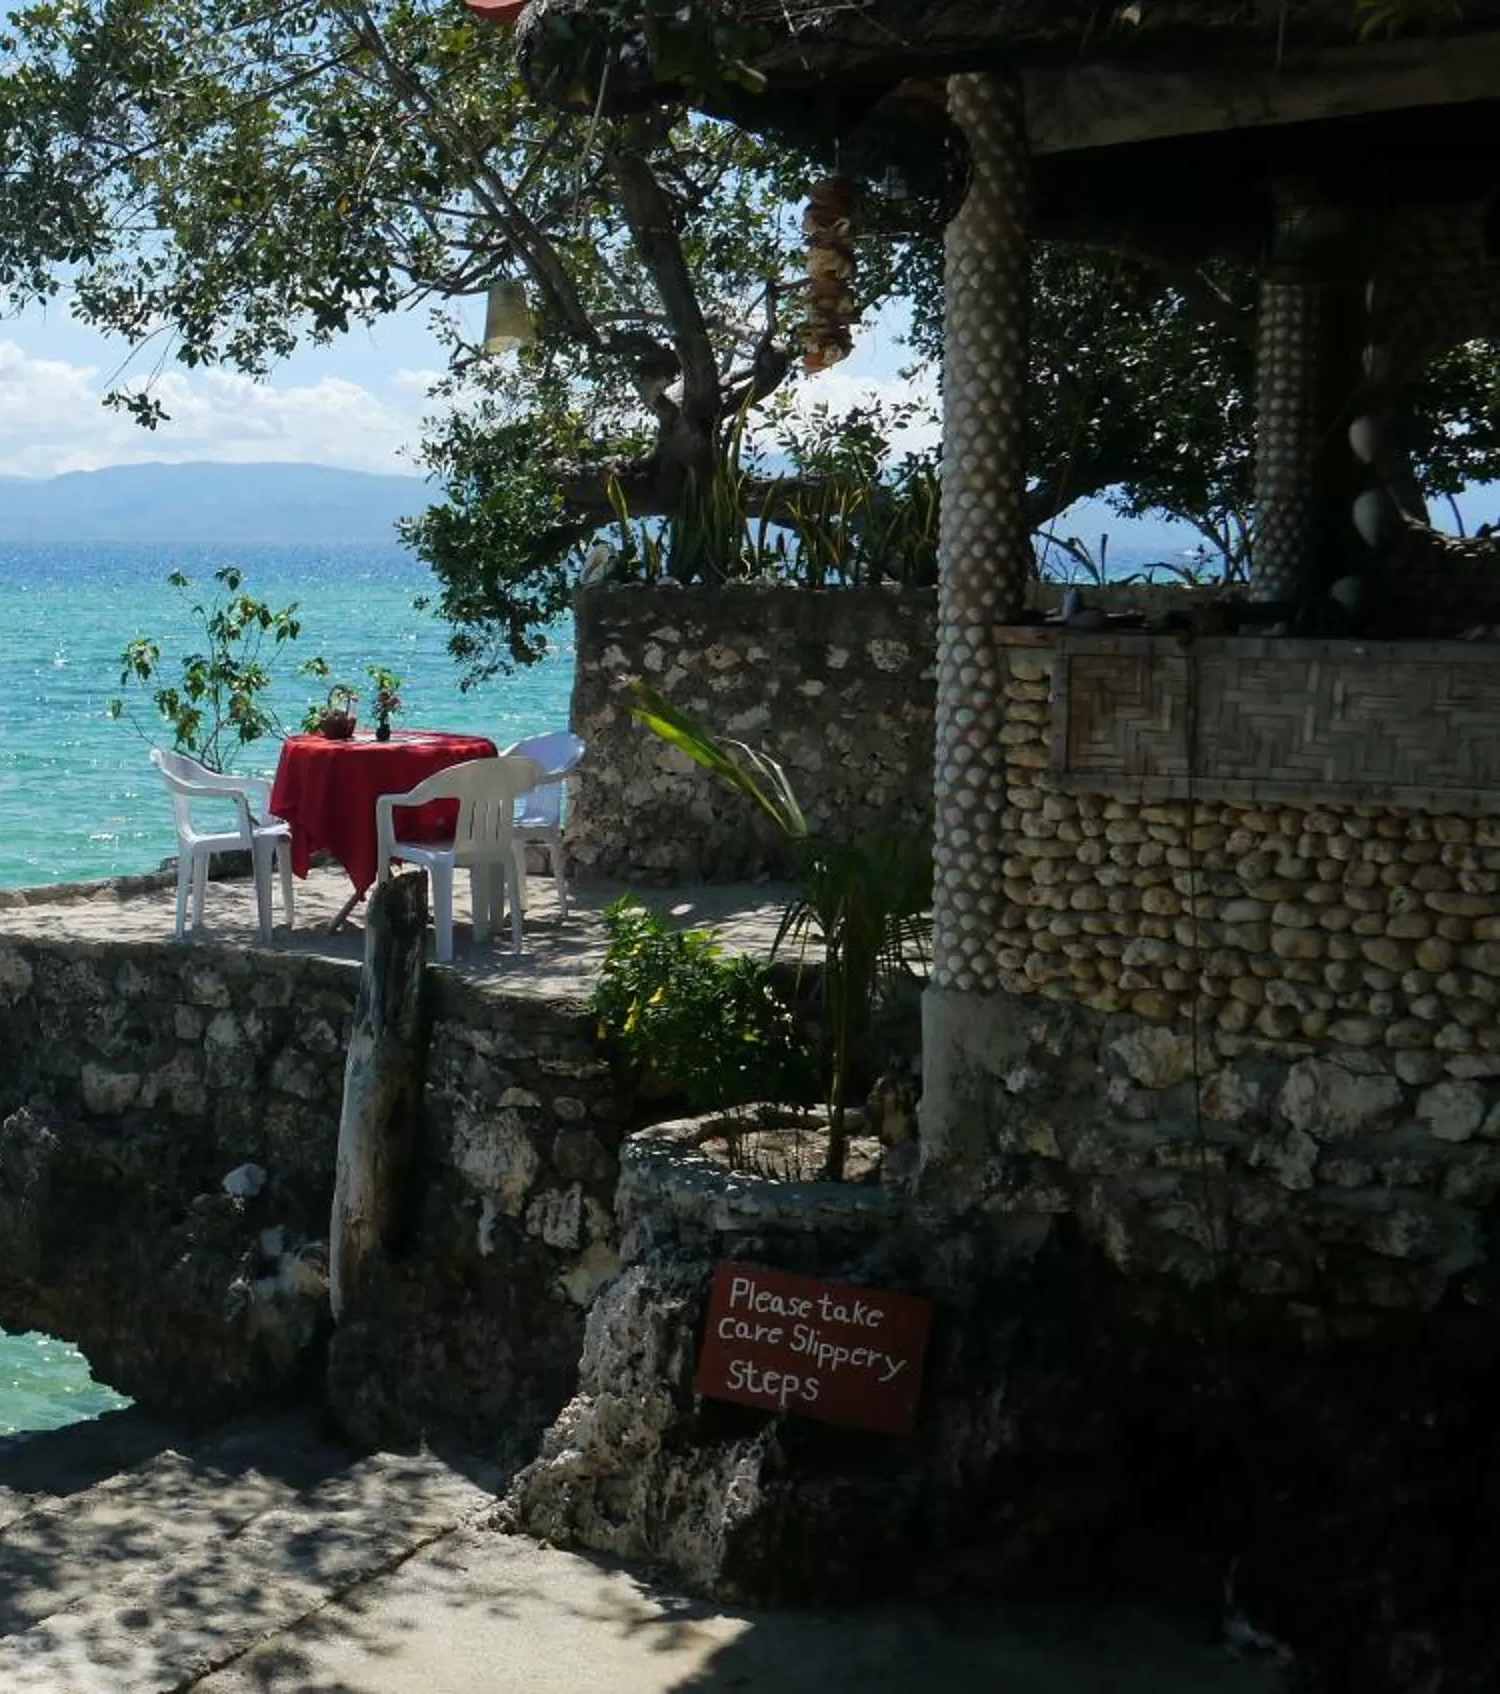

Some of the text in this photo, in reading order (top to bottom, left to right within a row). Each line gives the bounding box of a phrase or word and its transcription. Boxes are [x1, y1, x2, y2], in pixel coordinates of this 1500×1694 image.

[729, 1277, 885, 1327] Please take
[789, 1324, 907, 1382] Slippery
